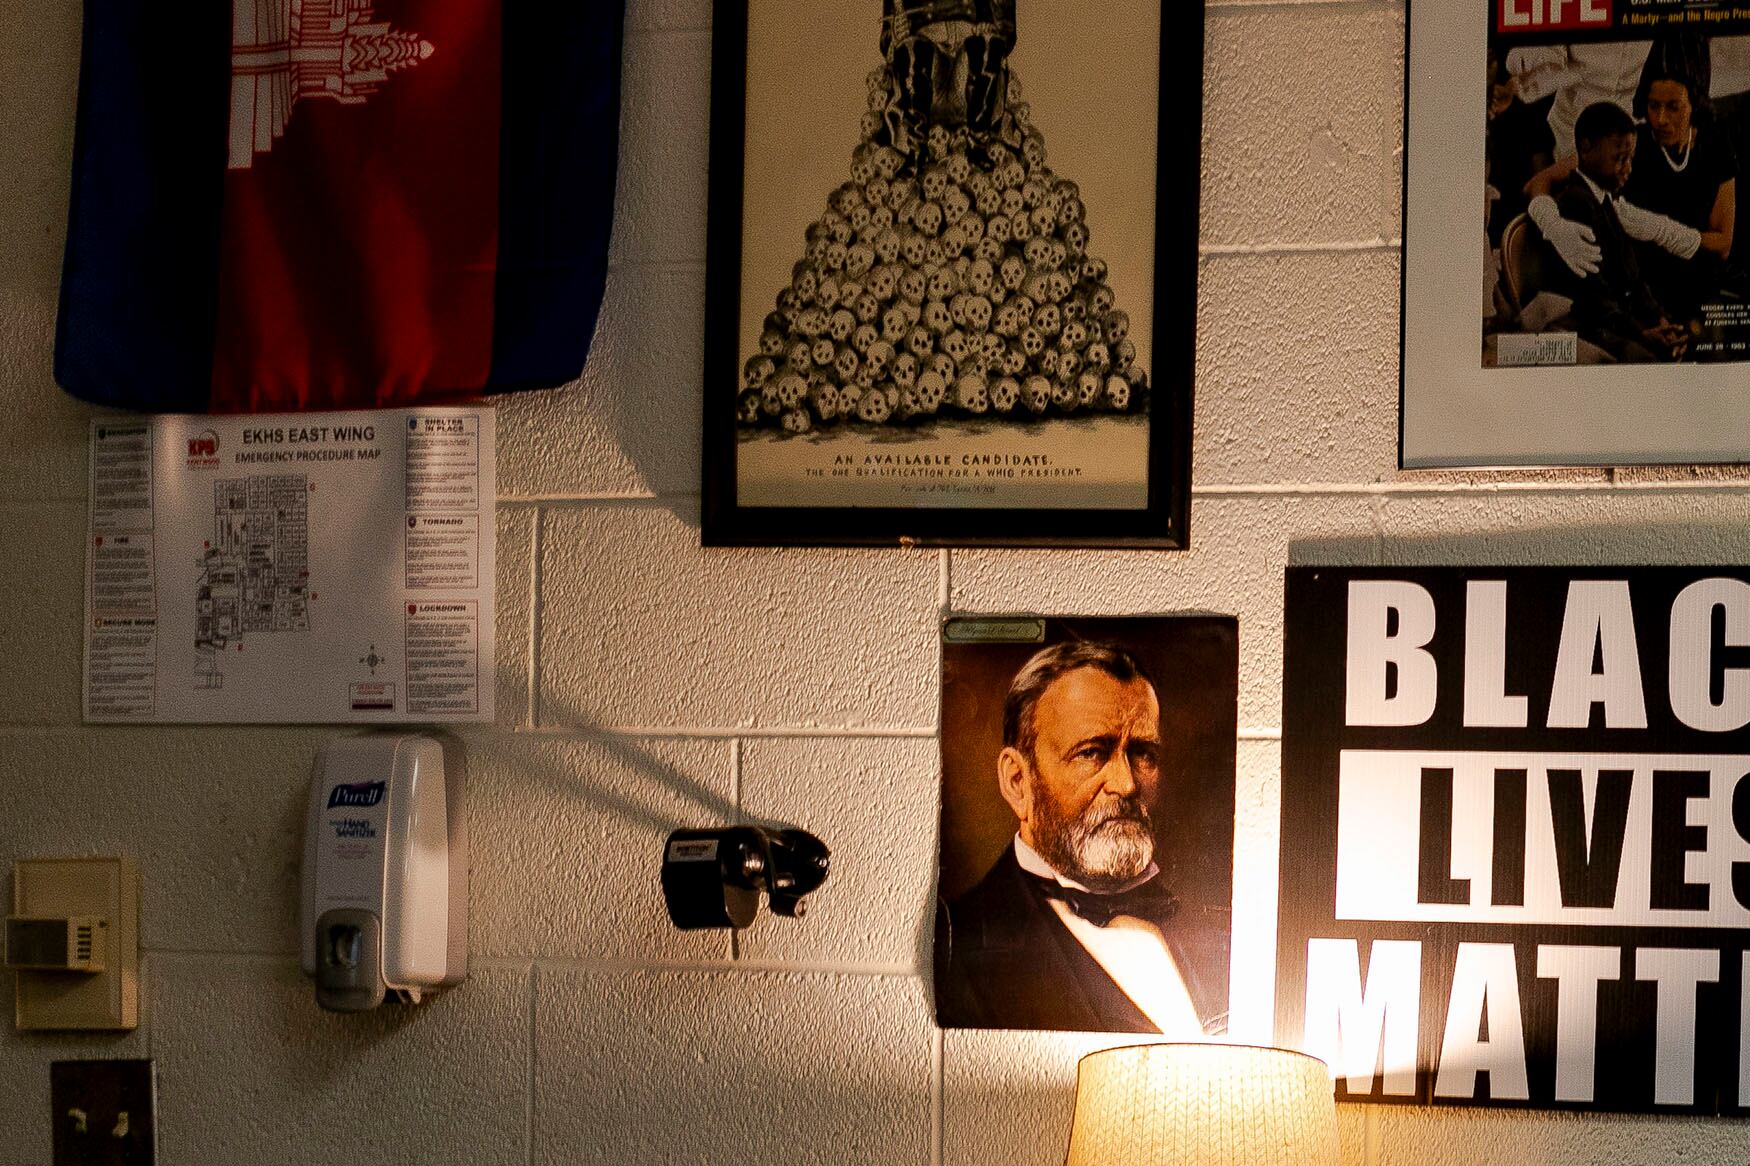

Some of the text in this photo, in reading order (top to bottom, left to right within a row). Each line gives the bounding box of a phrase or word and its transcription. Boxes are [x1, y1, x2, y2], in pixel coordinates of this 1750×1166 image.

[1503, 0, 1608, 26] LIFE
[1621, 14, 1628, 25] A
[1686, 11, 1700, 22] the
[1703, 9, 1730, 23] Negro
[243, 425, 375, 445] EKHS EAST WING
[234, 448, 381, 464] EMERGENCY PROCEDURE MAP
[834, 455, 854, 466] AN
[864, 454, 951, 466] AVAILABLE
